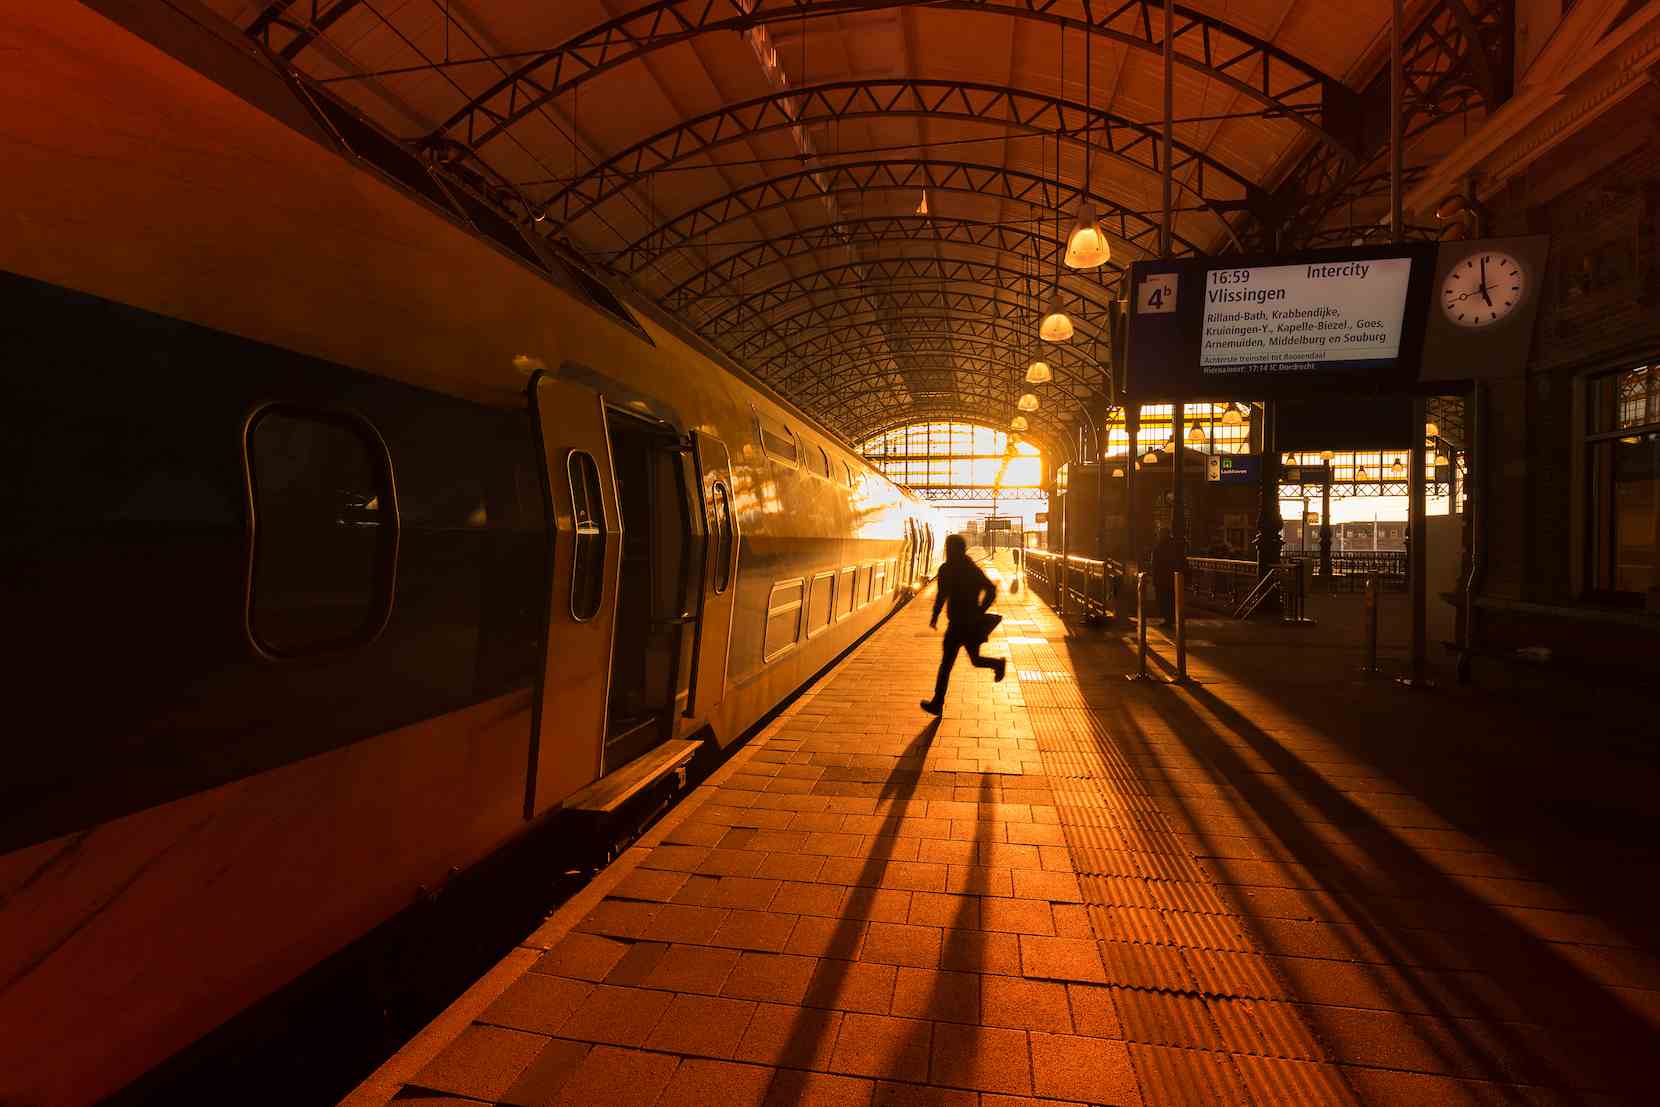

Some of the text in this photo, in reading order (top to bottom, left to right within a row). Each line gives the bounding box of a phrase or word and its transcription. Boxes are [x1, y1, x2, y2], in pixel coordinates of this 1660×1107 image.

[1212, 262, 1369, 285] 16:59 Intercity
[1208, 287, 1286, 304] Vlissingen
[1207, 306, 1340, 322] Rilland-Bath, Krabbendijke,
[1356, 320, 1385, 329] Goes,
[1205, 332, 1386, 349] Arnemuiden, Middelburg en Souburg
